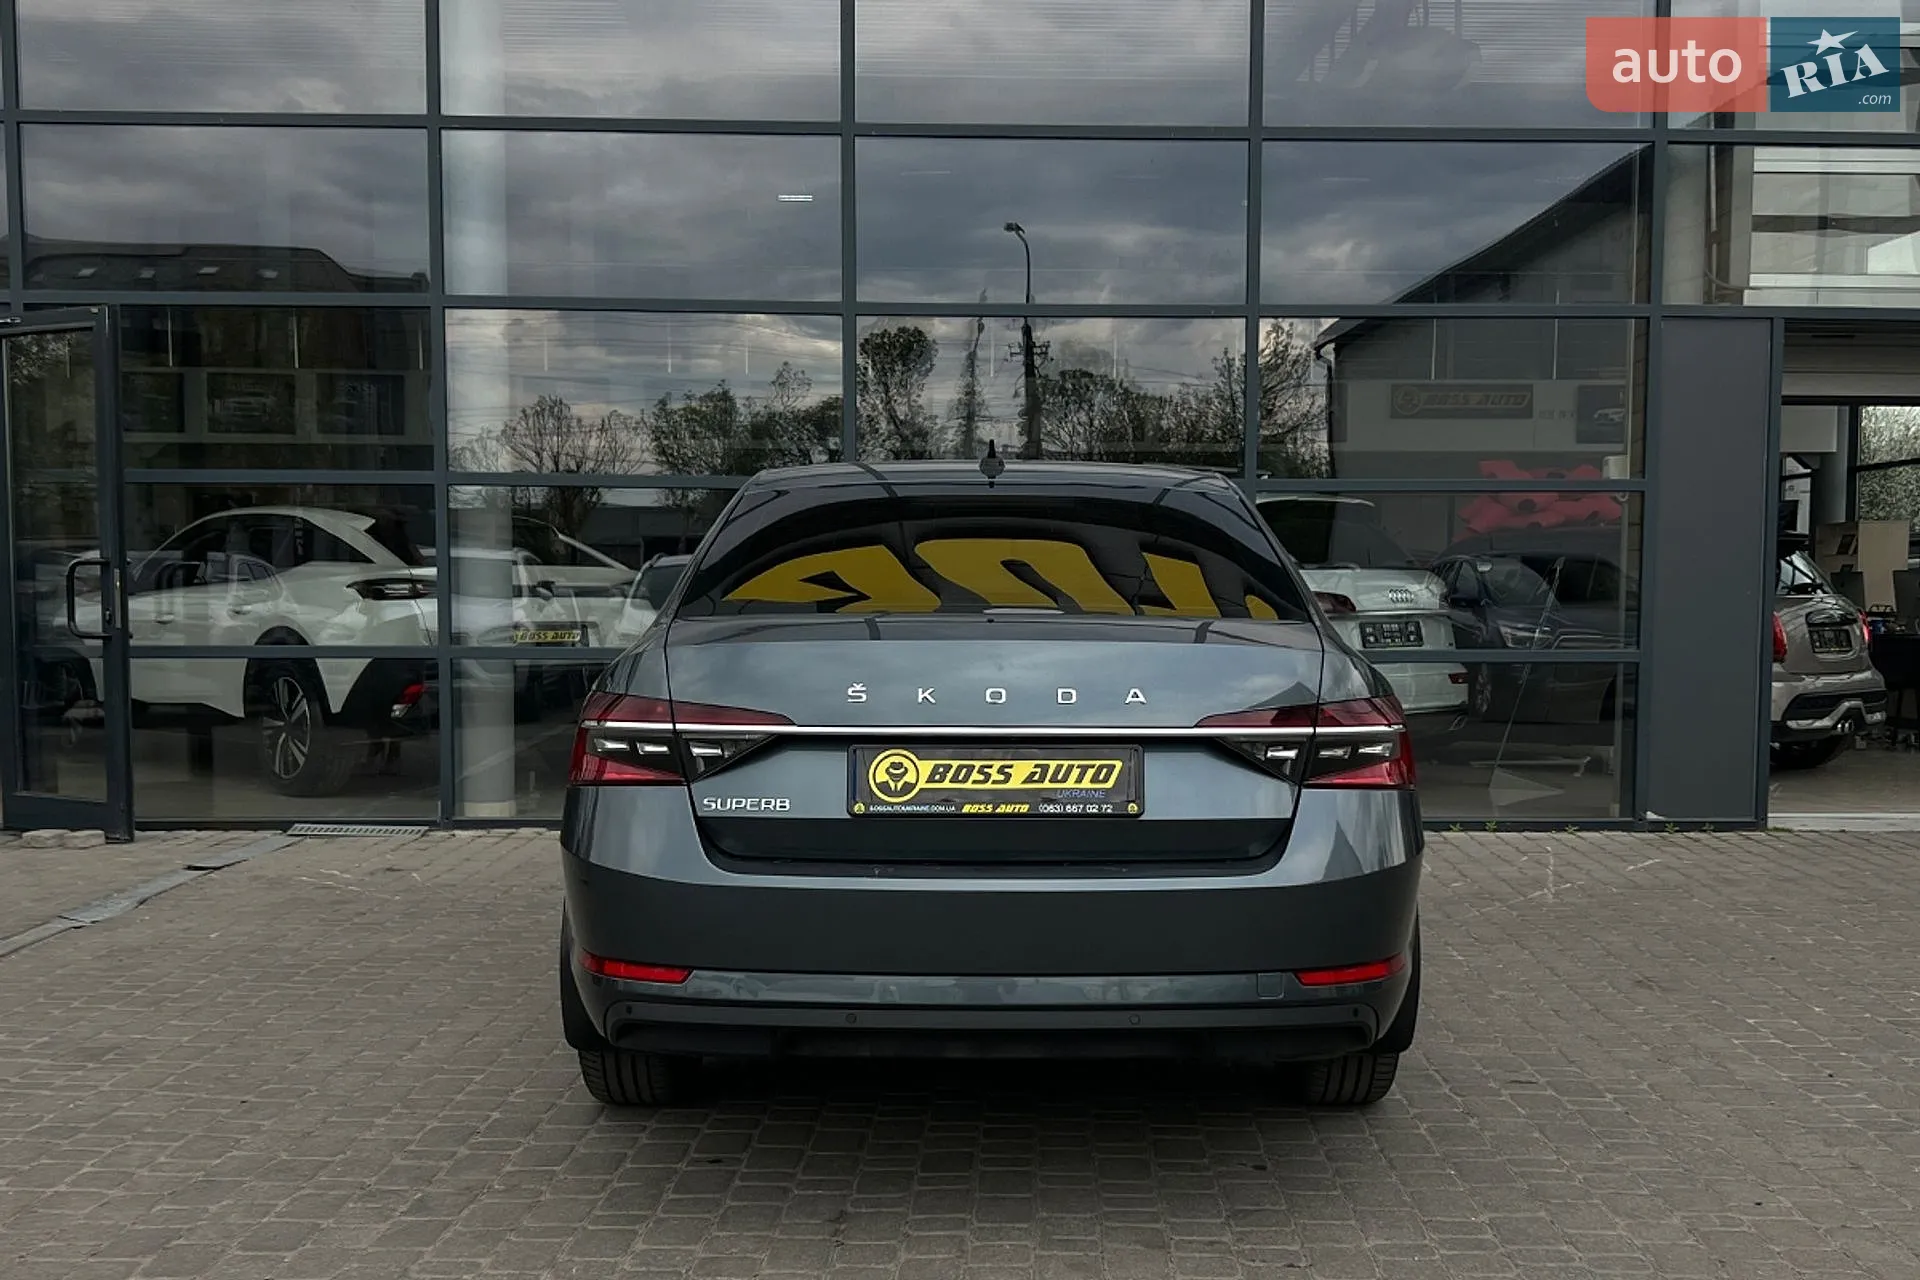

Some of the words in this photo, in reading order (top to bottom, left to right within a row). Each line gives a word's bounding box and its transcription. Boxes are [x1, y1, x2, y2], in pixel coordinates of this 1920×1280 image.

[925, 764, 1013, 785] BOSS
[1020, 764, 1116, 785] AUTO
[1056, 789, 1106, 799] UKRAINE
[703, 798, 790, 811] SUPERB
[962, 803, 993, 813] BOSS
[995, 803, 1029, 813] AUTO
